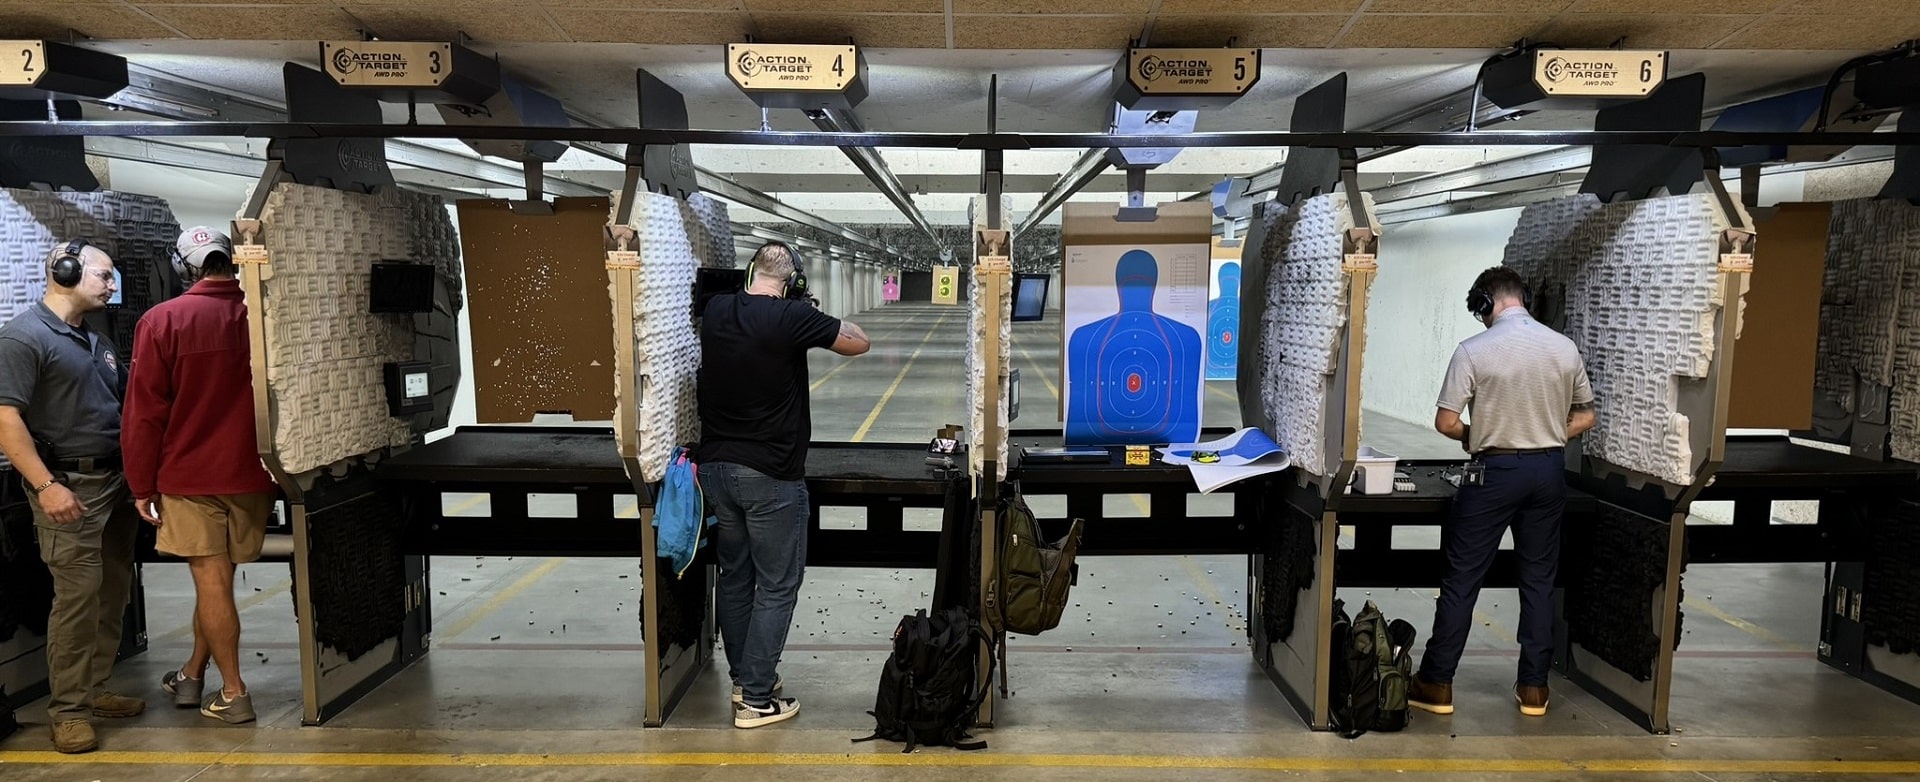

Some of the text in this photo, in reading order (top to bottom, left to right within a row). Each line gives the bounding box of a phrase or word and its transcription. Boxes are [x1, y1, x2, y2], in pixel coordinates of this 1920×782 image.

[21, 49, 34, 72] 2
[429, 50, 441, 74] 3
[756, 56, 807, 64] ACTION
[358, 62, 408, 70] TARGET
[763, 65, 813, 73] TARGET
[831, 54, 844, 77] 4
[1234, 57, 1246, 81] 5
[1563, 62, 1614, 70] ACTION
[1163, 69, 1213, 77] TARGET
[1569, 71, 1618, 79] TARGET
[1640, 59, 1652, 83] 6
